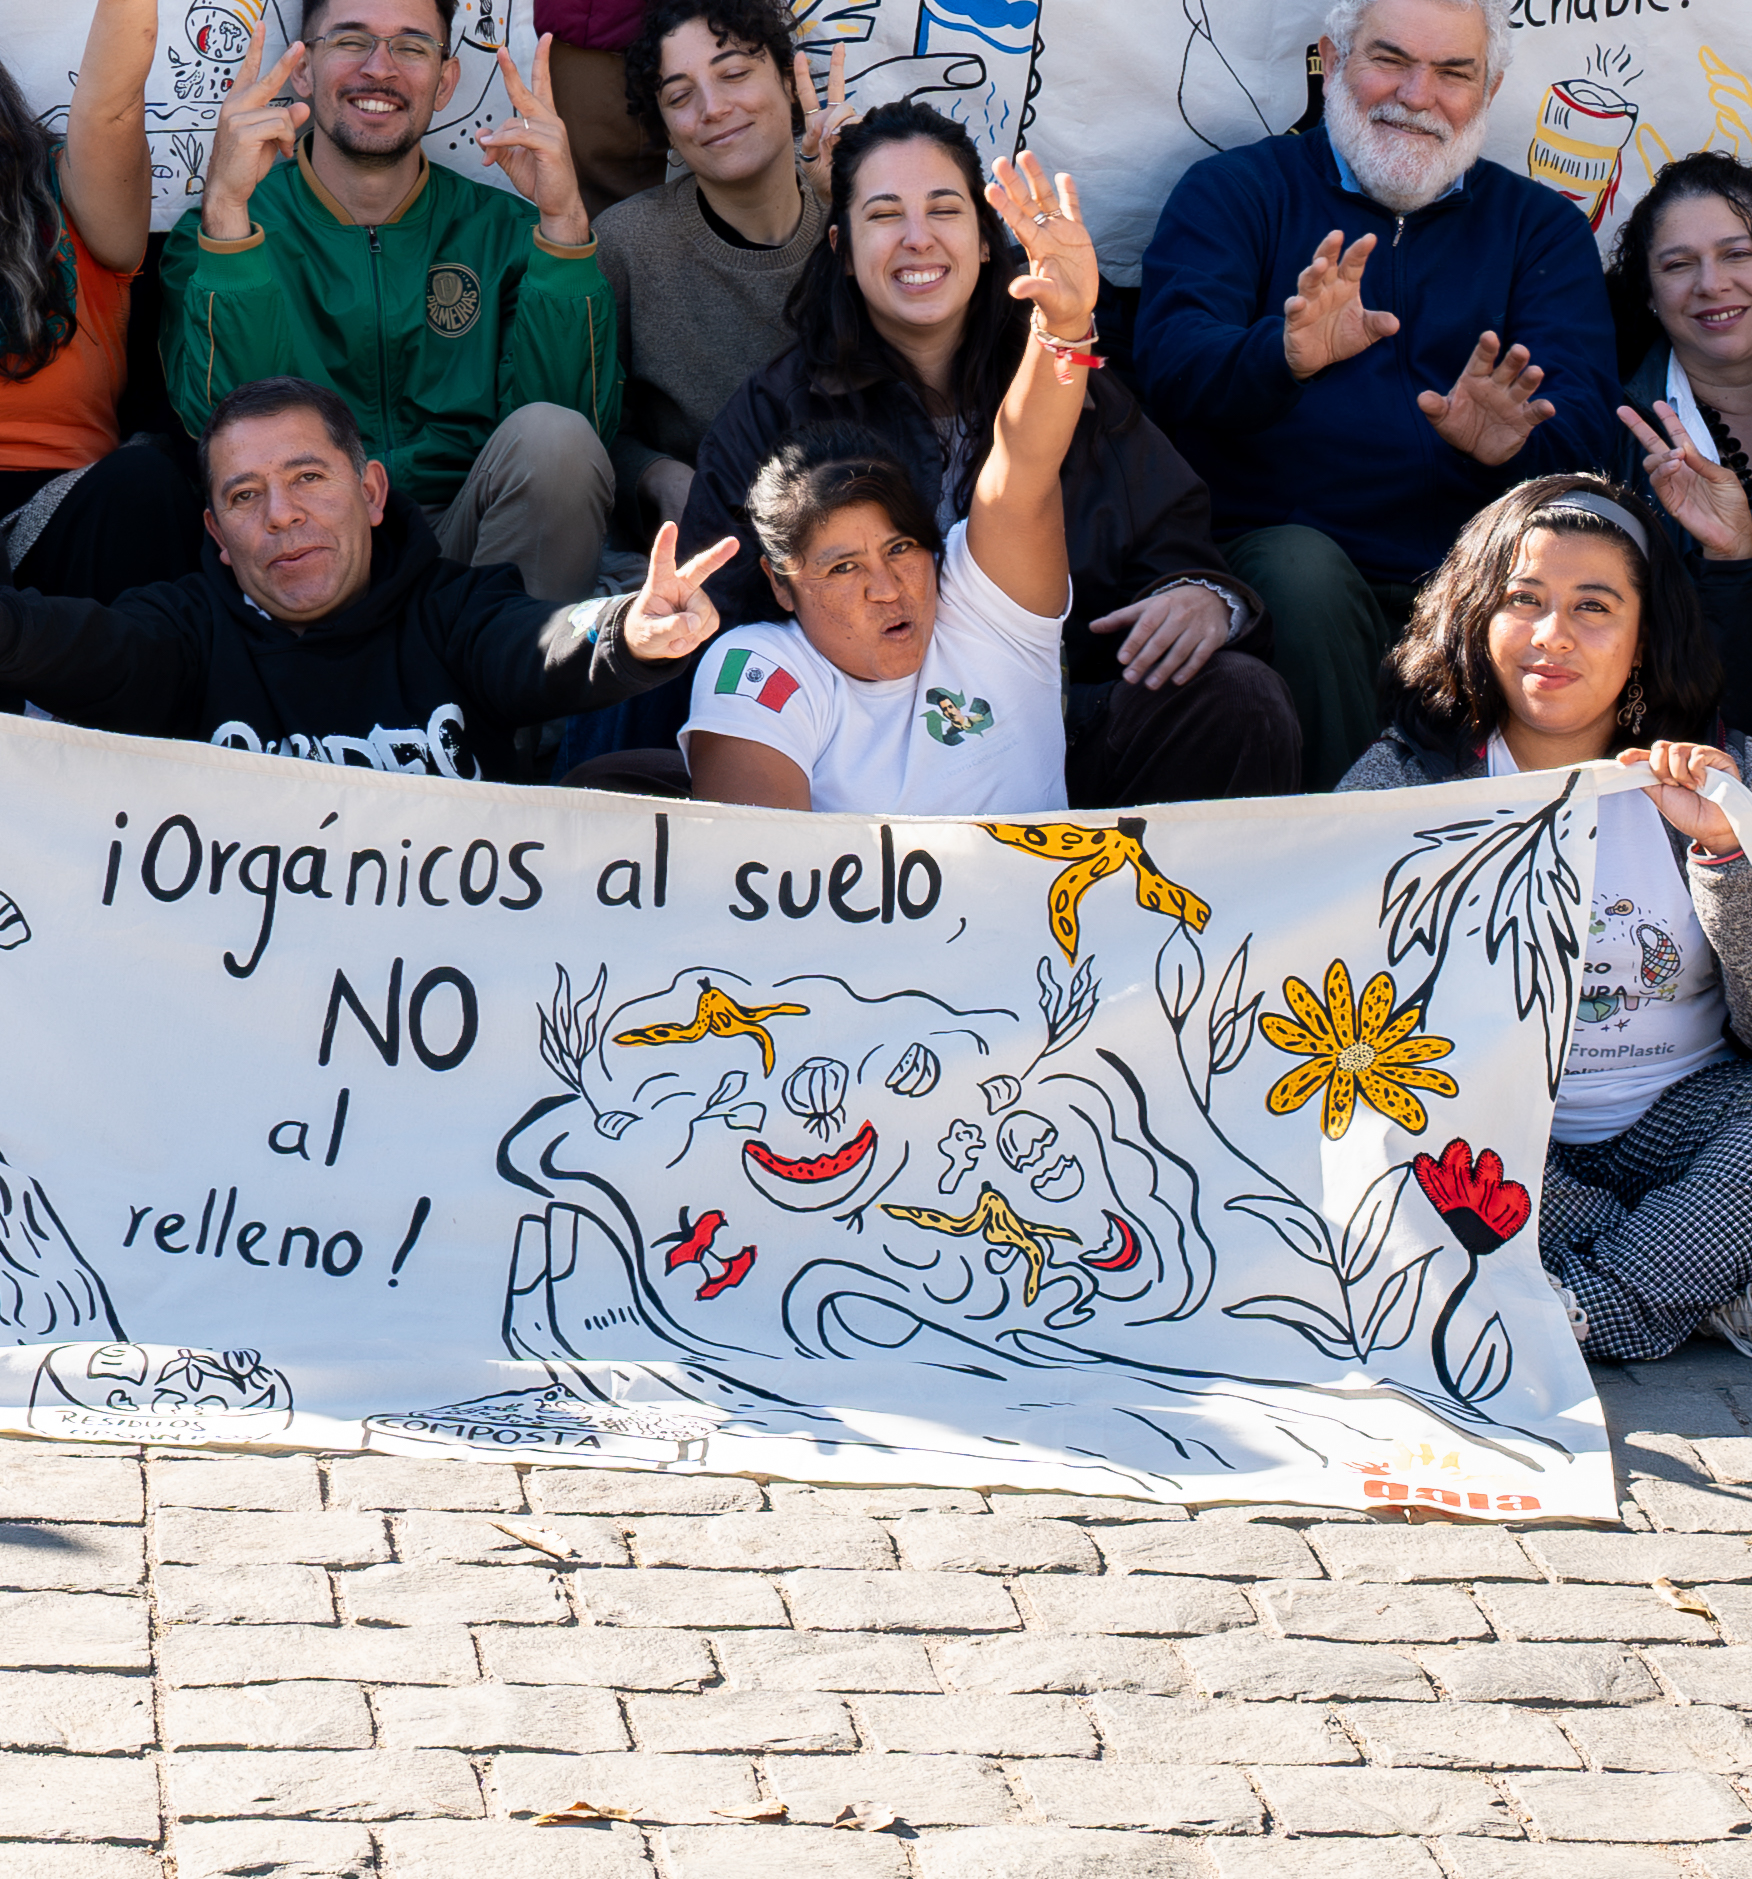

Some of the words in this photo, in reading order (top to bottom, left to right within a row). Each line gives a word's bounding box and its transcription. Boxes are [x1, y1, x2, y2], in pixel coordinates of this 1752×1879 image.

[426, 290, 478, 330] PALMEIRAS
[102, 810, 546, 980] ¡Orgánicos
[596, 811, 669, 909] al
[728, 823, 967, 944] suelo,
[318, 956, 478, 1072] NO
[1569, 1041, 1676, 1059] FromPlastic
[267, 1087, 351, 1168] al
[375, 1417, 603, 1450] COMPOSTA
